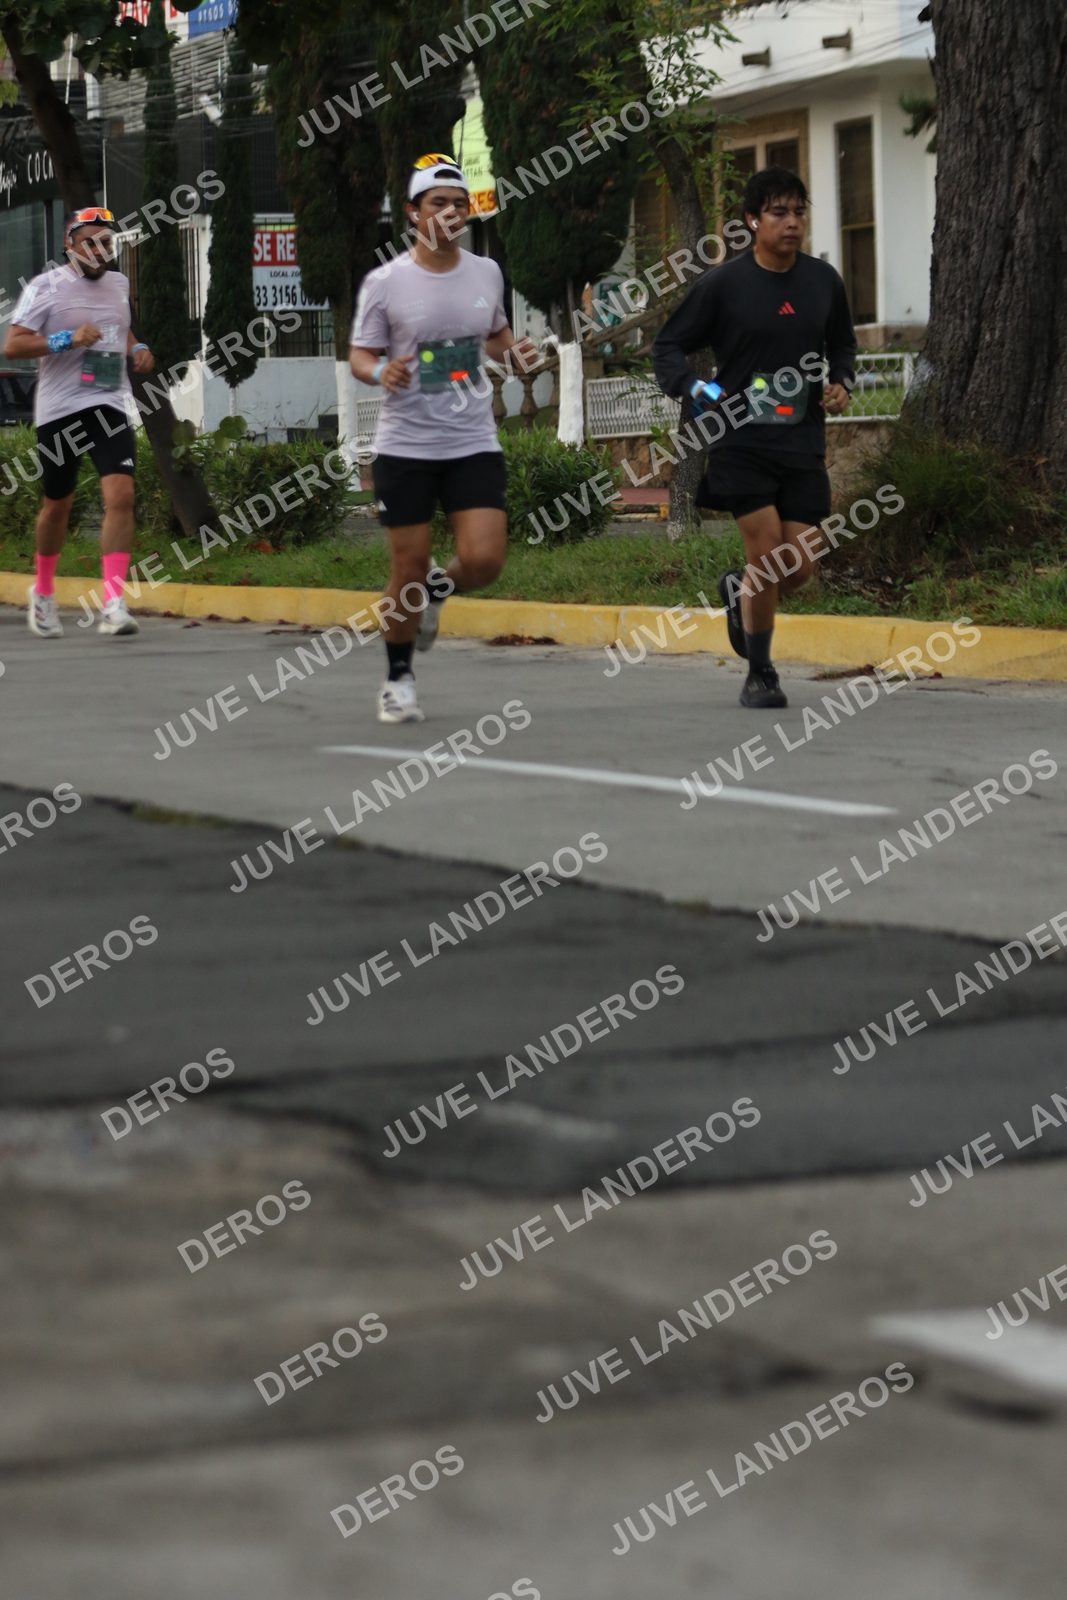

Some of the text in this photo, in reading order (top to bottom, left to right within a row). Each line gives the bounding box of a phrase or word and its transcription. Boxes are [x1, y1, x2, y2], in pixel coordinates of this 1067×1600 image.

[254, 233, 272, 262] SE
[256, 285, 268, 306] 33
[272, 285, 298, 306] 3156
